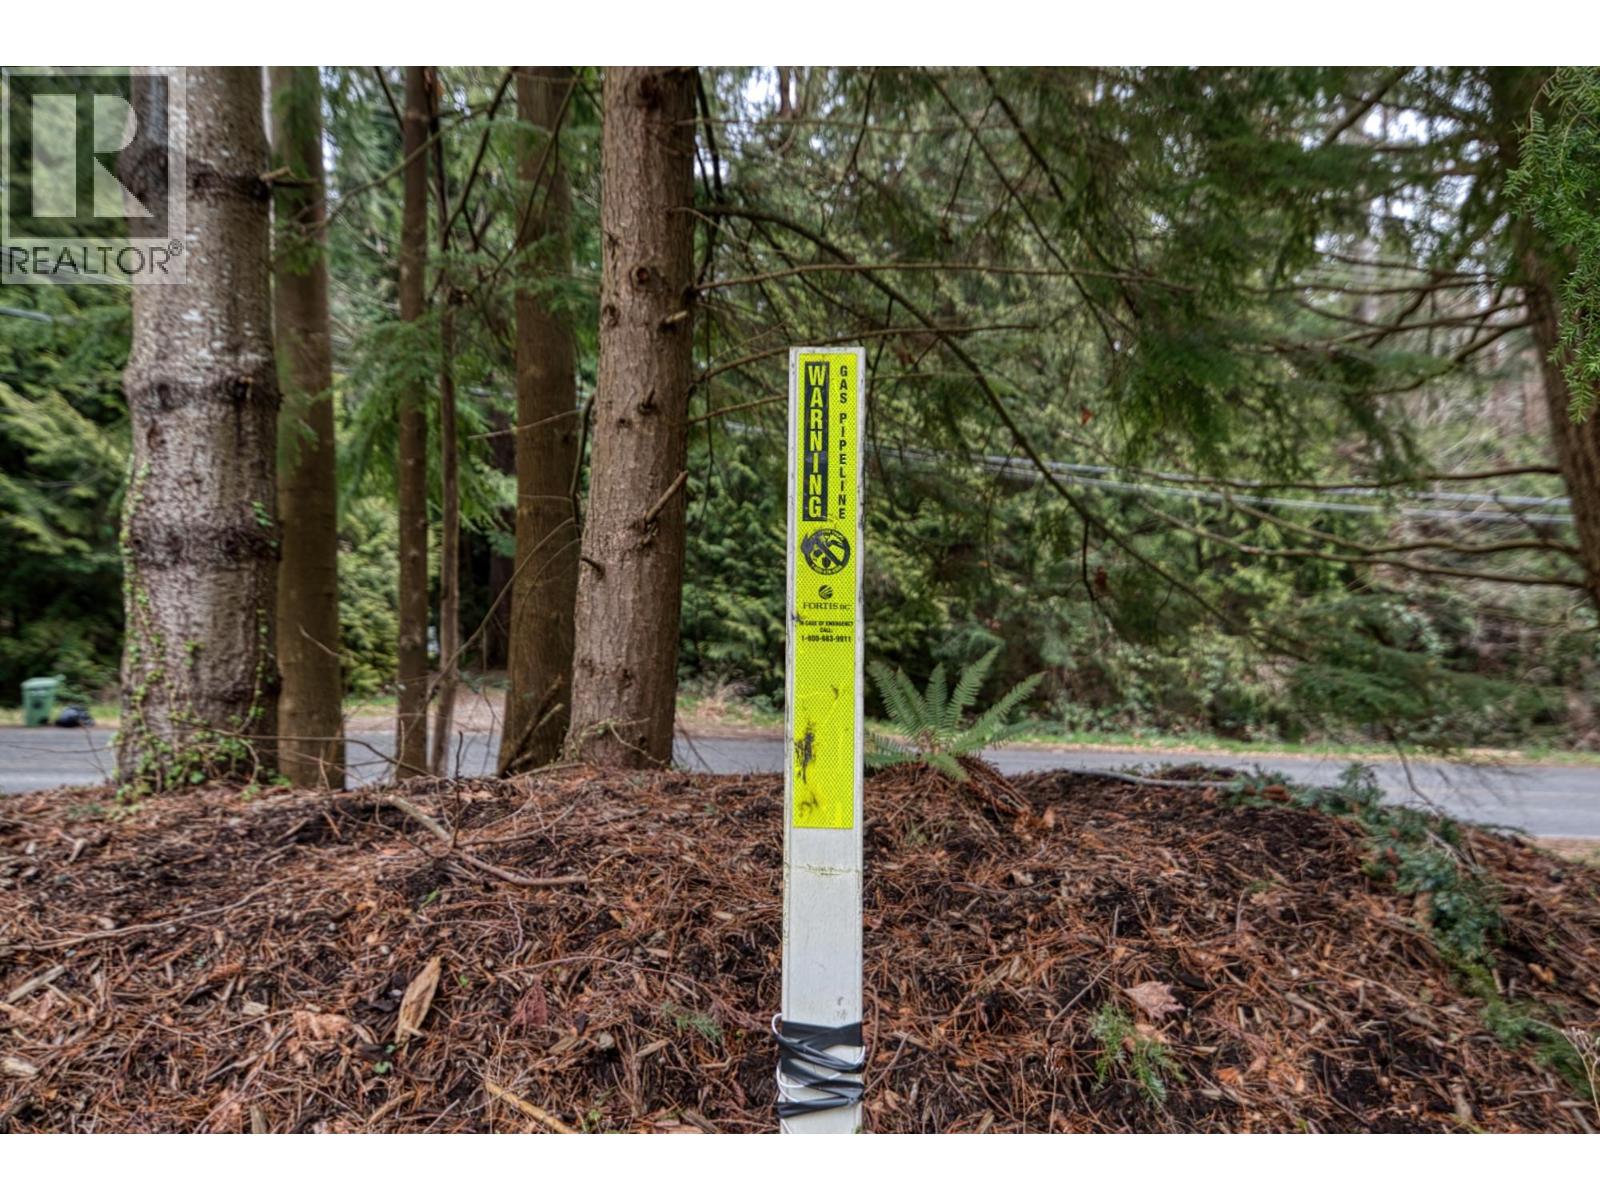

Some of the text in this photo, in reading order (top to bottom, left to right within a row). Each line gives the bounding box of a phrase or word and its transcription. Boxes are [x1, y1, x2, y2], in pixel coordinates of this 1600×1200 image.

[808, 365, 826, 518] WARNING
[838, 365, 848, 519] GAS PIPELINE
